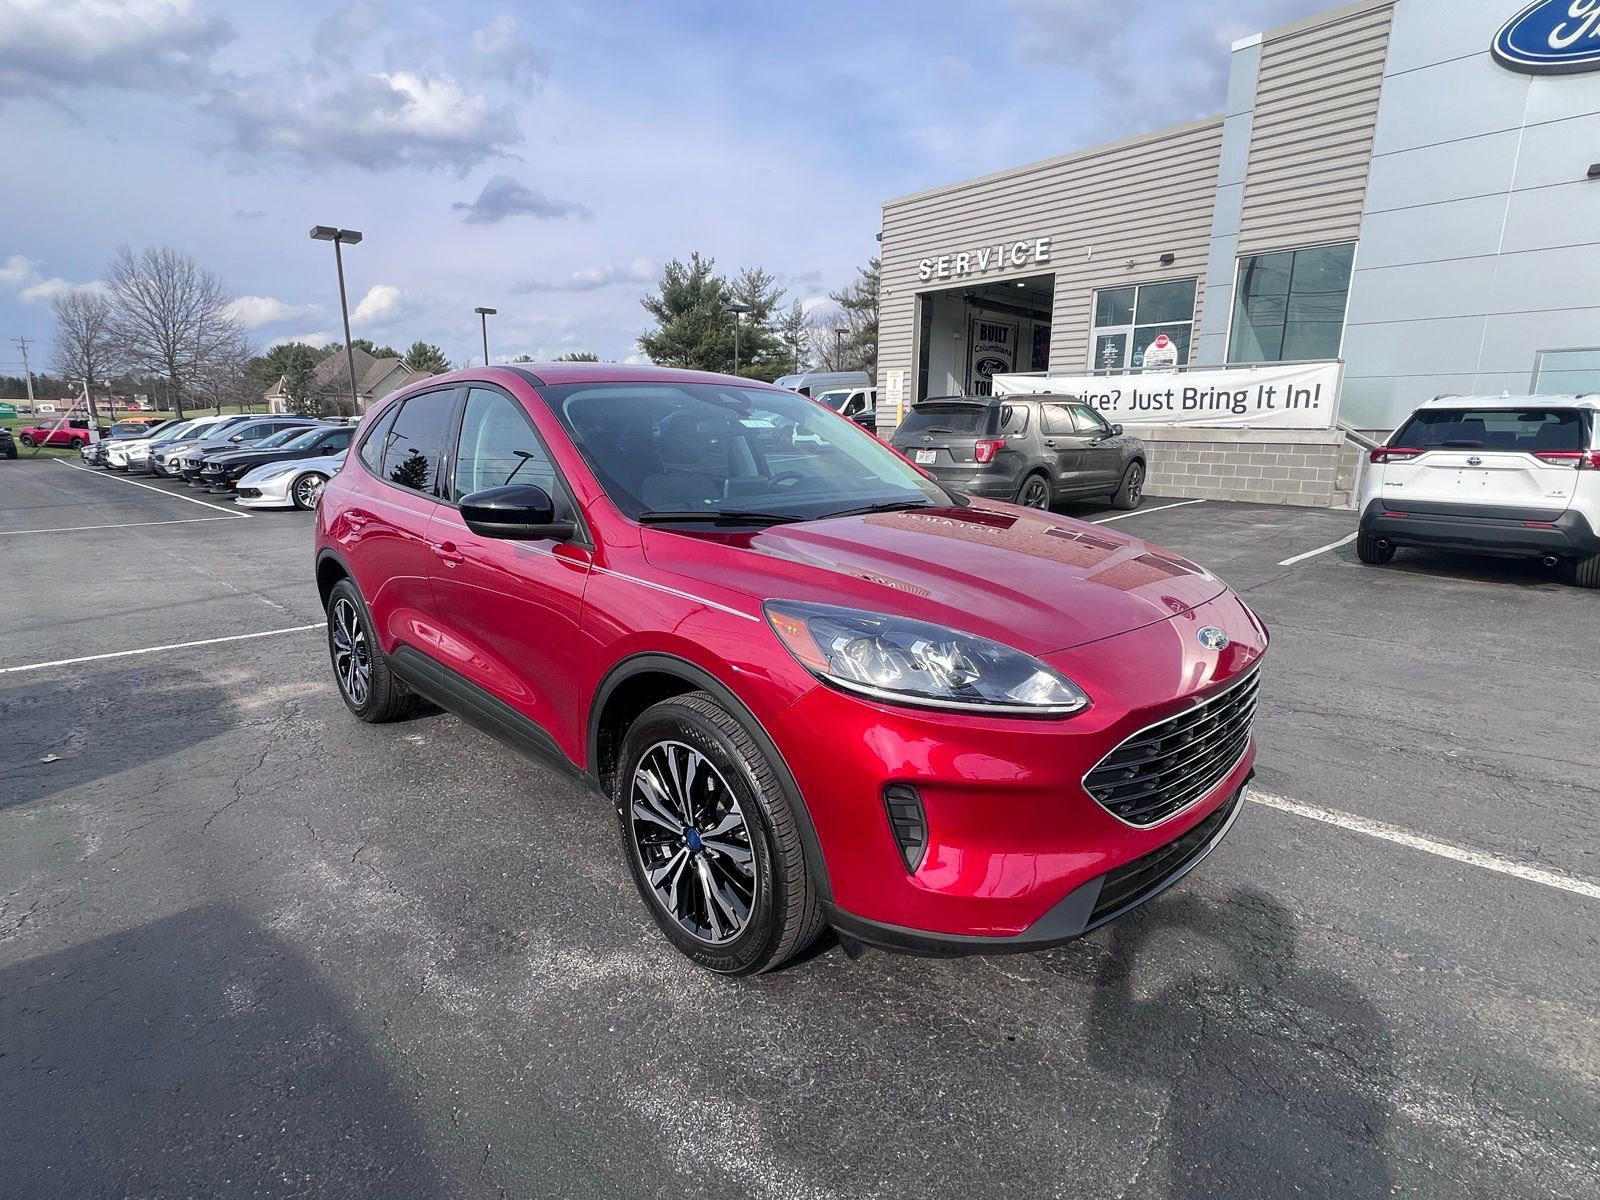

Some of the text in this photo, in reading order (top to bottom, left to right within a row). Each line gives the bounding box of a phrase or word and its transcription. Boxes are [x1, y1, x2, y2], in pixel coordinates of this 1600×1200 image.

[918, 236, 1053, 281] SERVICE
[980, 323, 1009, 344] BUILT
[974, 344, 1012, 357] Columbiana
[974, 380, 993, 397] TOU
[1128, 388, 1175, 411] Just
[1182, 386, 1249, 414] Bring
[1256, 384, 1277, 409] It
[1285, 383, 1322, 409] In!
